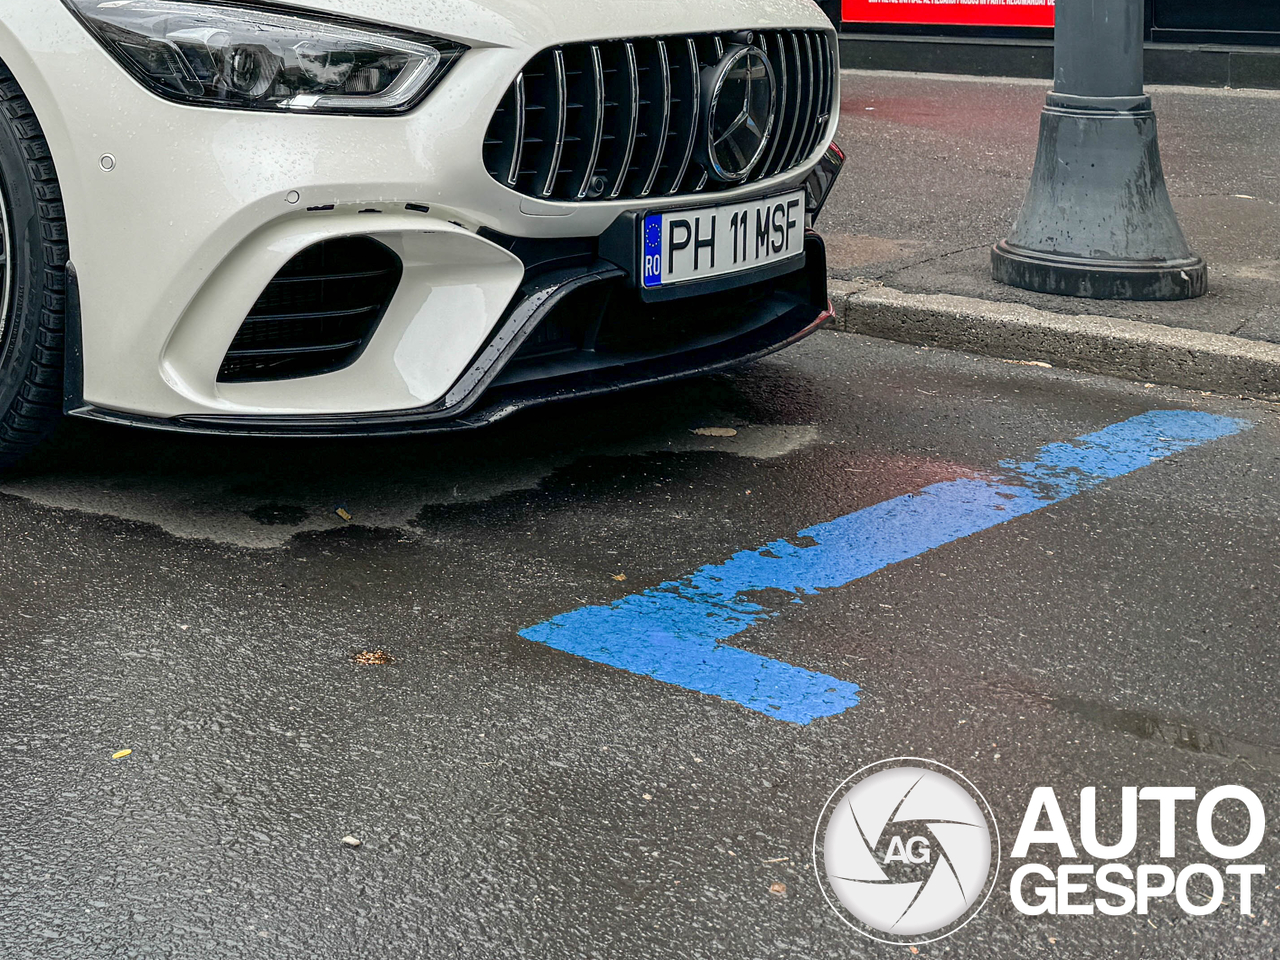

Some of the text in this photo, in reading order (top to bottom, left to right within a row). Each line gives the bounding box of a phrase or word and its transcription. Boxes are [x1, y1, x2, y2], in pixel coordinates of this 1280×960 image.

[668, 198, 799, 274] PH 11 MSF
[645, 254, 661, 277] RO
